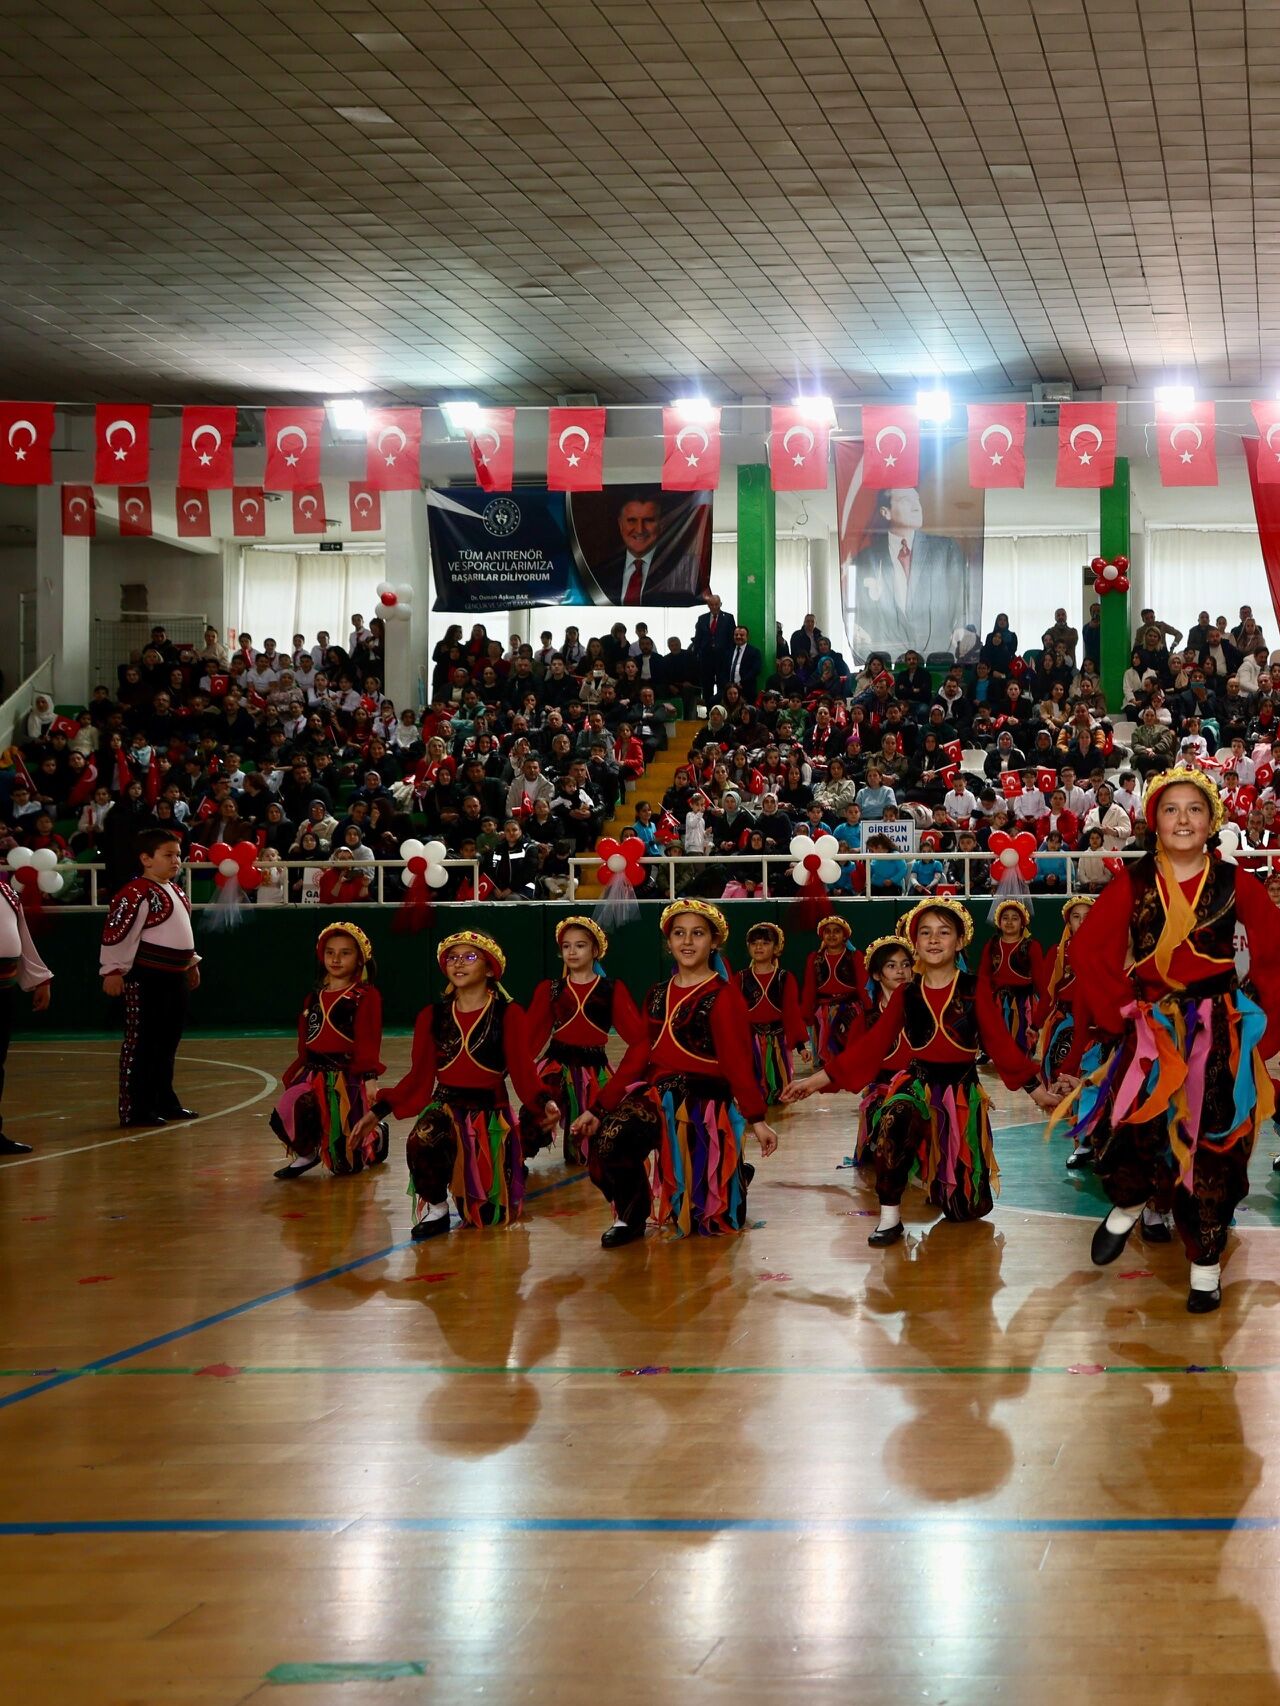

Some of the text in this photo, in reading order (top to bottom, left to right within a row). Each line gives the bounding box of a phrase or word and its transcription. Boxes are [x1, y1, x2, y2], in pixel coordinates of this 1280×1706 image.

[459, 549, 542, 560] TÜM ANTRENÖR
[448, 561, 554, 571] VE SPORCULARIMIZA
[452, 572, 550, 583] BAŞARILAR DİLİYORUM
[868, 824, 907, 833] GİRESUN
